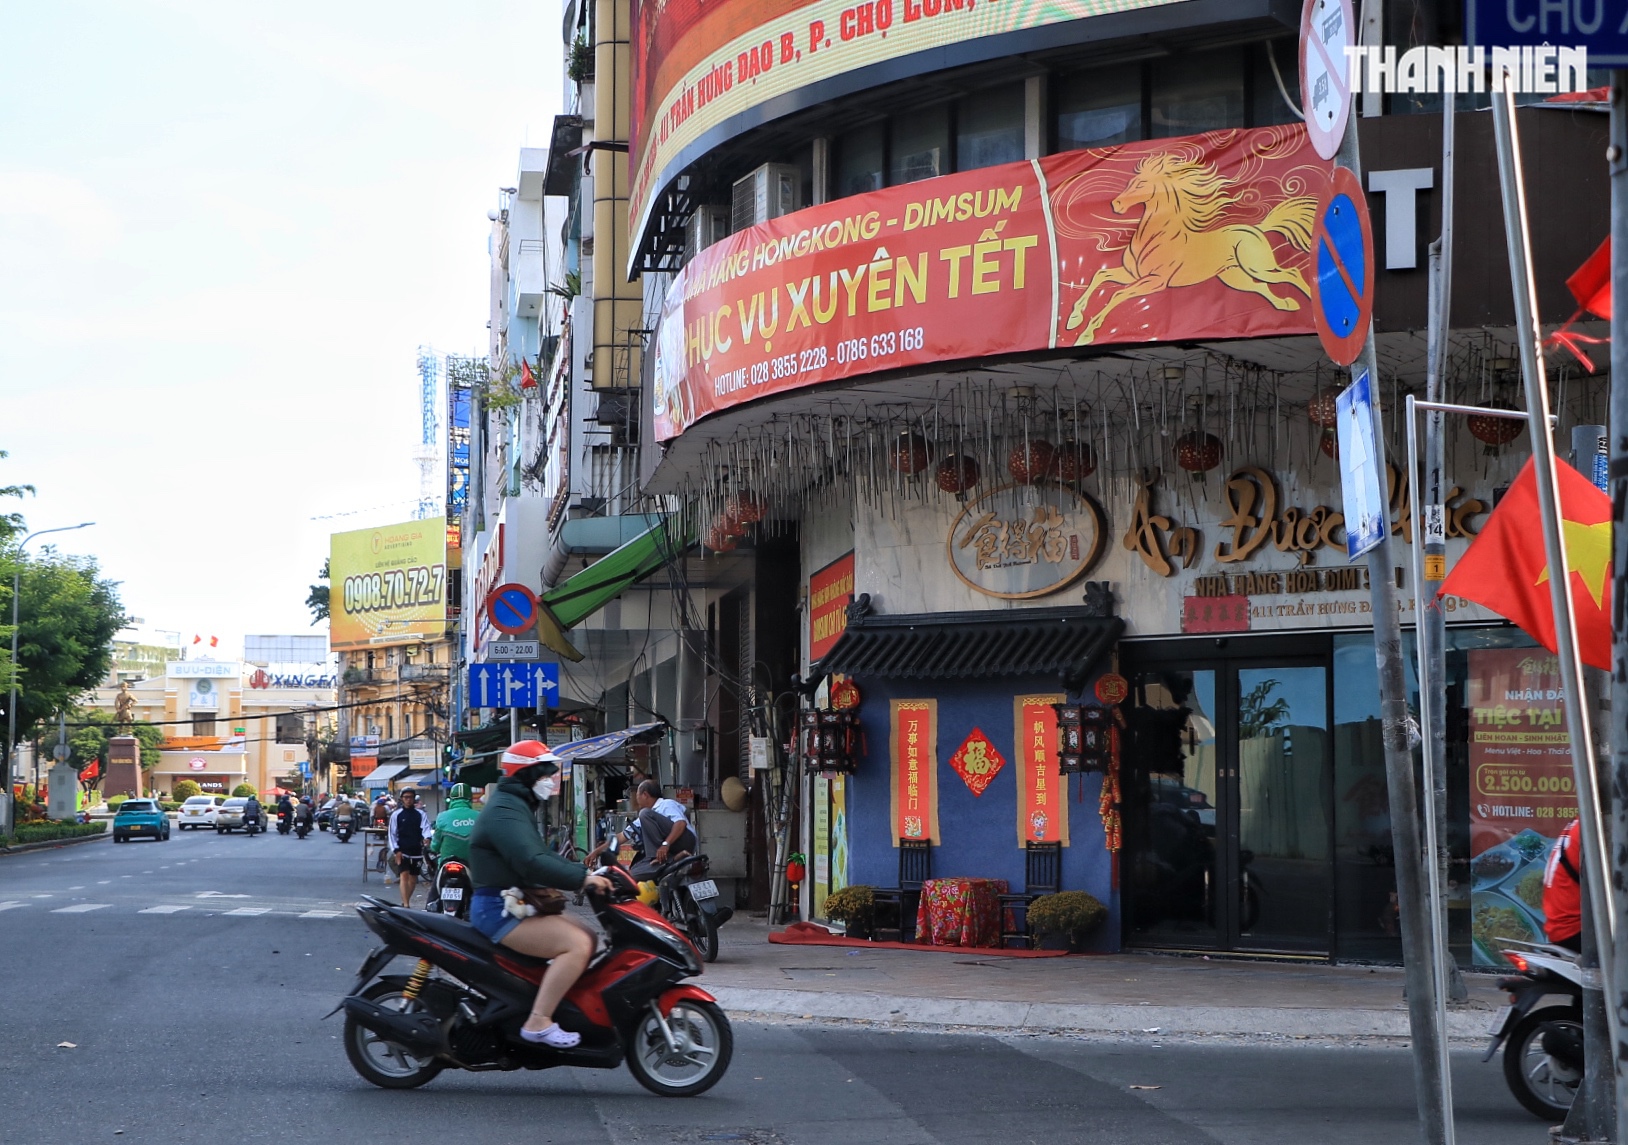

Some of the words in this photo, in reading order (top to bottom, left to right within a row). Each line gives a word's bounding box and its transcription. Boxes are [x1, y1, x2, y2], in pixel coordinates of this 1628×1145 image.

[671, 80, 694, 133] TRẦN
[698, 61, 733, 109] HƯNG
[737, 41, 773, 85] ĐẠO
[780, 32, 801, 63] B,
[810, 21, 831, 53] P.
[840, 0, 893, 40] CHỢ
[1368, 167, 1434, 270] T
[707, 247, 749, 292] HÀNG
[752, 211, 881, 273] HONGKONG
[902, 185, 1025, 233] DIMSUM
[737, 287, 779, 354] VỤ
[786, 246, 928, 334] XUYÊN
[939, 219, 1039, 299] TẾT
[714, 373, 749, 398] HOTLINE:
[750, 364, 770, 387] 028
[771, 357, 798, 381] 3855
[799, 351, 827, 375] 2228
[837, 339, 867, 366] 0786
[871, 332, 896, 359] 633
[898, 326, 924, 352] 168
[1195, 571, 1228, 597] NHÀ
[1234, 569, 1280, 596] HÀNG
[1325, 568, 1357, 592] DIM
[1252, 605, 1273, 618] 411
[1276, 597, 1314, 616] TRẦN
[1316, 600, 1356, 616] HƯNG
[190, 692, 197, 707] P
[201, 696, 208, 704] &
[211, 692, 218, 707] T
[1505, 688, 1543, 703] NHẬN
[1546, 687, 1566, 703] ĐẶ
[1473, 705, 1522, 730] TIỆC
[1526, 708, 1562, 730] TẠI
[1476, 732, 1493, 741] LIÊN
[1495, 734, 1518, 742] HOAN
[1524, 734, 1543, 742] SINH
[1545, 734, 1567, 743] NHẬT
[1484, 747, 1505, 755] Menu
[1506, 747, 1521, 755] Việt
[963, 741, 991, 775] 福
[1033, 710, 1047, 806] 一帆风顺吉星到
[452, 817, 475, 828] Grab
[1492, 805, 1534, 818] HOTLINE:
[1536, 806, 1555, 818] 028
